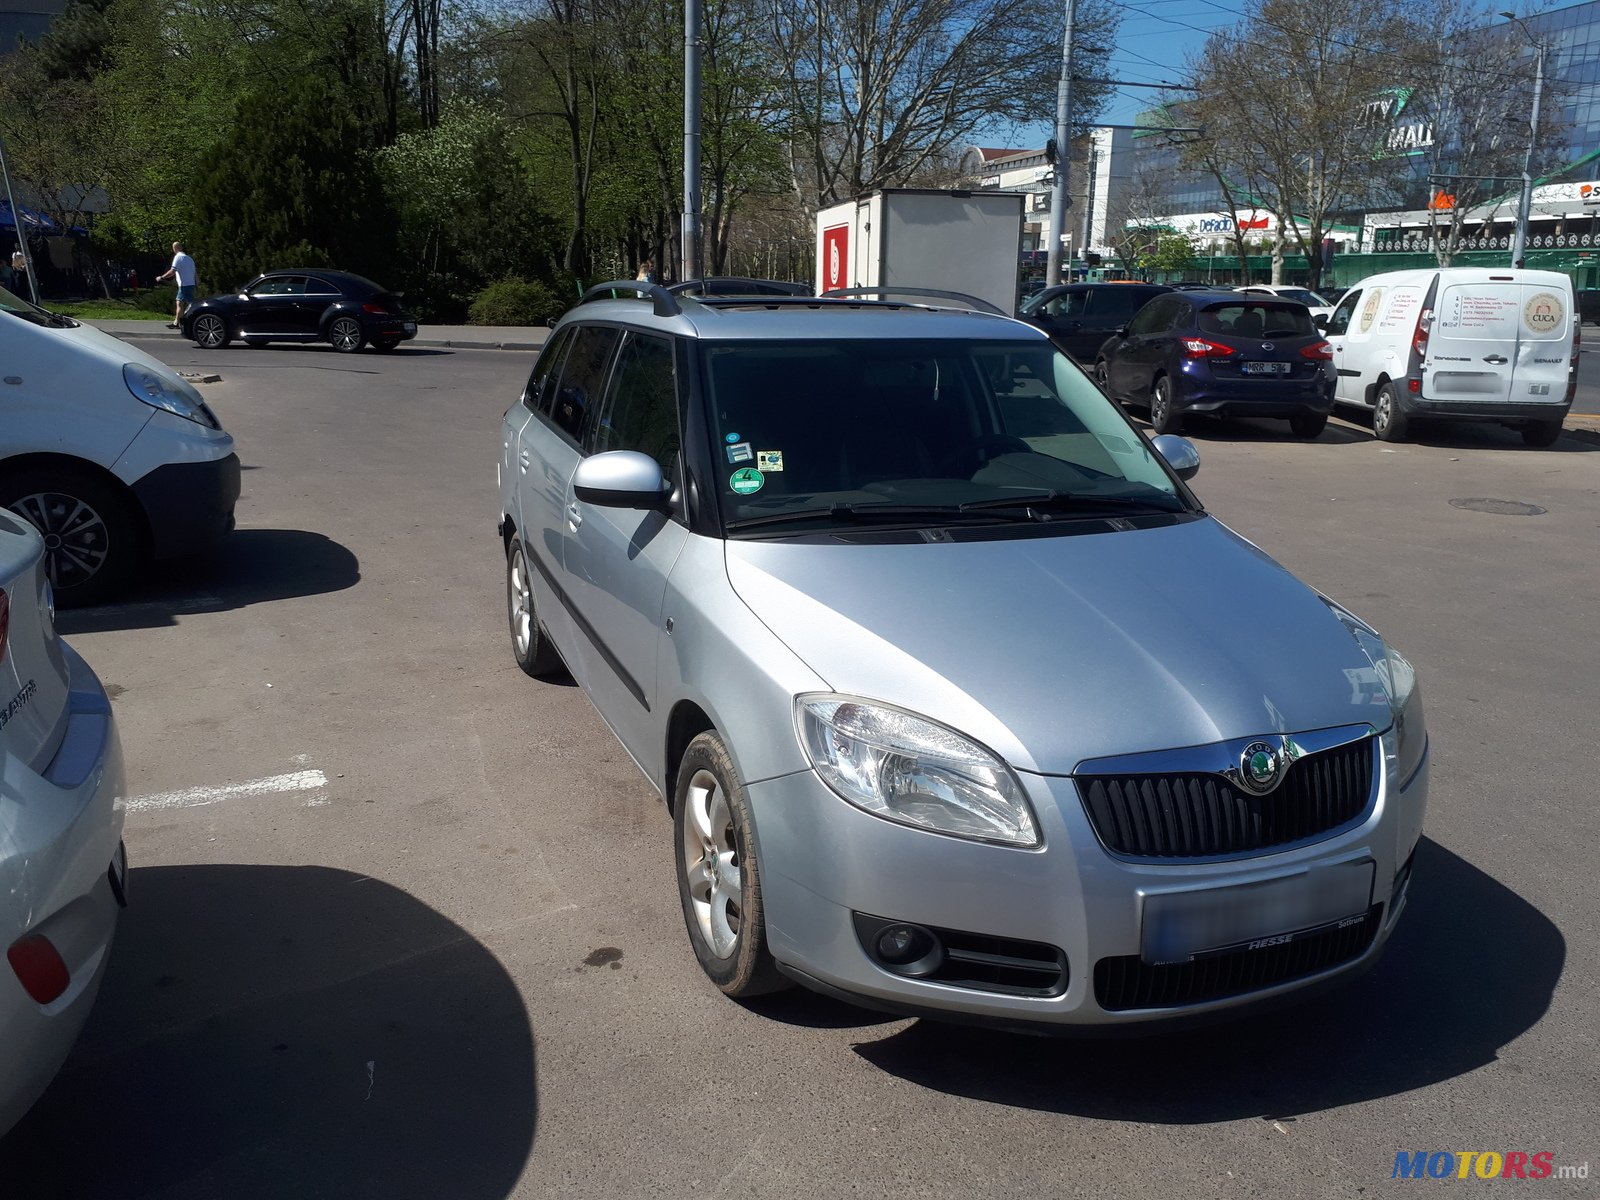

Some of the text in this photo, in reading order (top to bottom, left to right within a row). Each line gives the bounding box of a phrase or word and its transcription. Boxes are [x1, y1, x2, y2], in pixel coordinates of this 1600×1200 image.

[1387, 122, 1435, 150] MALL
[1532, 314, 1555, 323] CUCA
[1248, 363, 1265, 372] MRR
[742, 469, 752, 480] 4
[1248, 934, 1294, 950] HESSE
